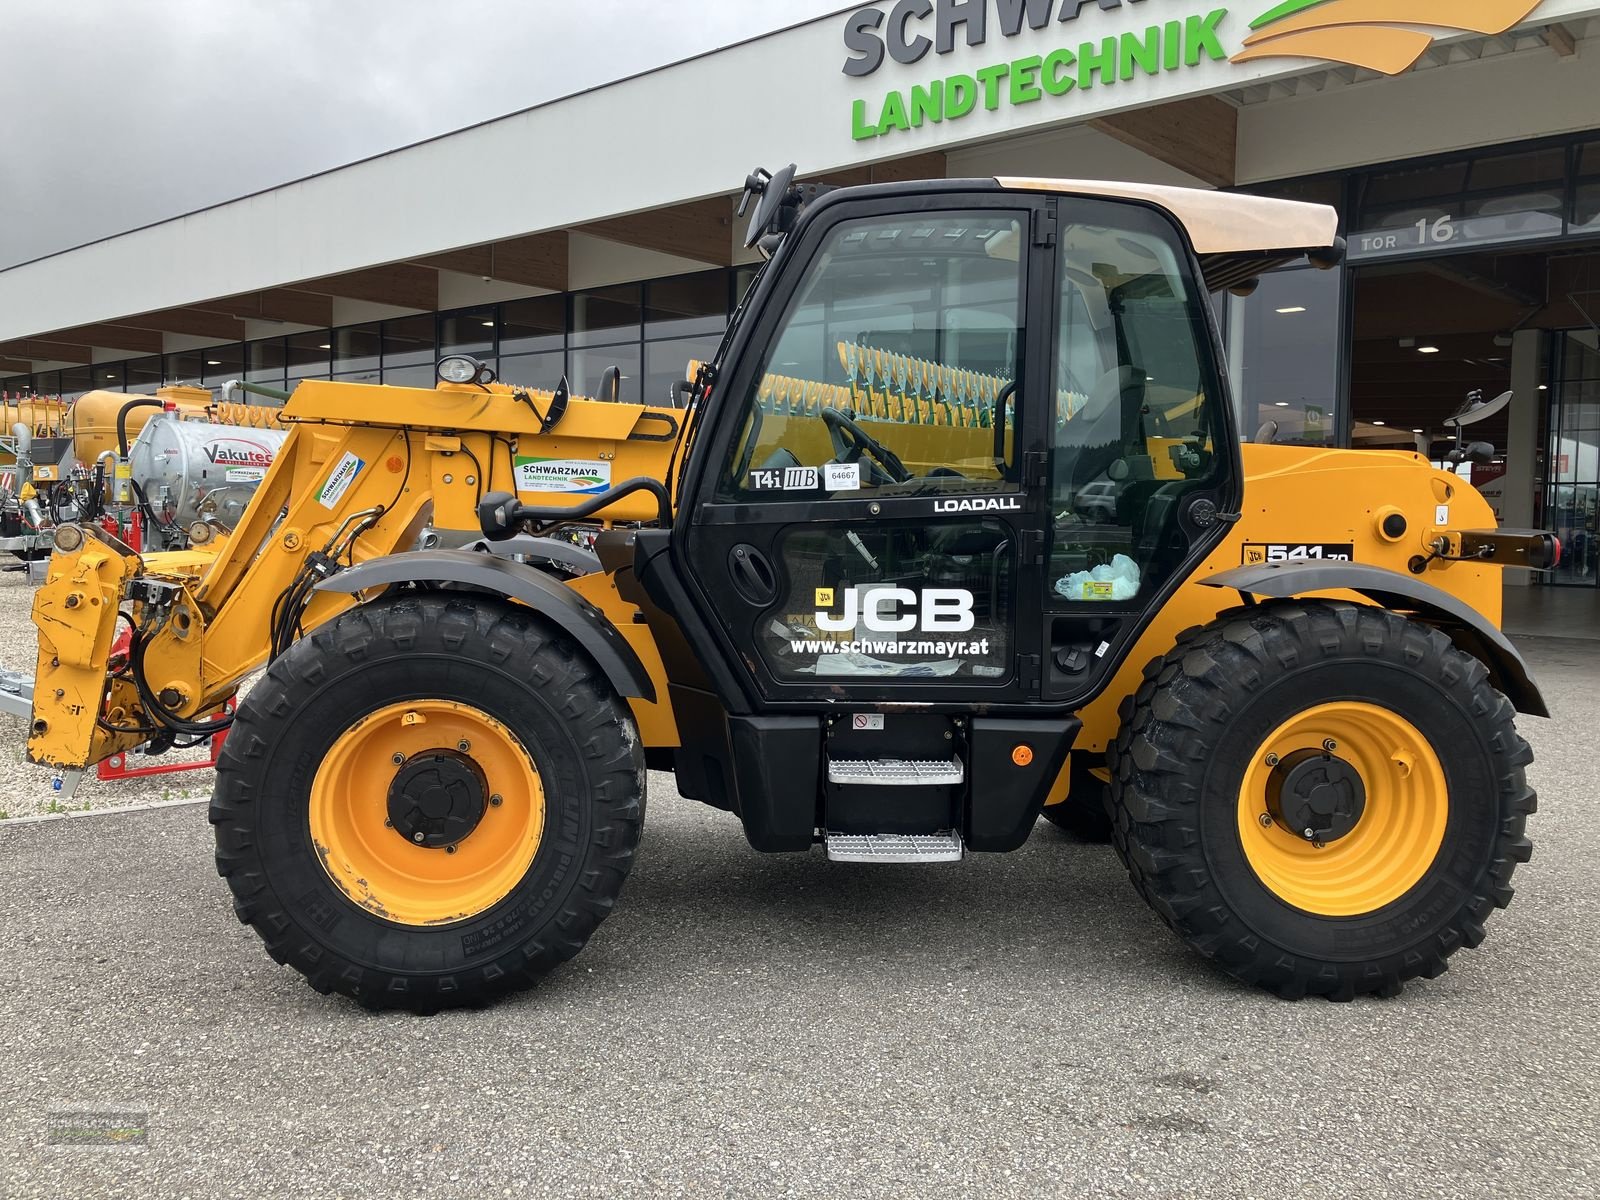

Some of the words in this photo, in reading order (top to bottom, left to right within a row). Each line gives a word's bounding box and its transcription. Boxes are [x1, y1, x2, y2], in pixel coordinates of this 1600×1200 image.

[852, 8, 1228, 141] LANDTECHNIK
[1361, 235, 1397, 251] TOR
[1415, 215, 1453, 244] 16
[203, 444, 273, 464] Vakutec
[321, 460, 351, 499] SCHWARZMAYR
[523, 465, 598, 476] SCHWARZMAYR
[831, 471, 856, 480] 64667
[934, 498, 1020, 512] LOADALL
[815, 588, 975, 632] JCB
[791, 637, 989, 658] www.schwarzmayr.at
